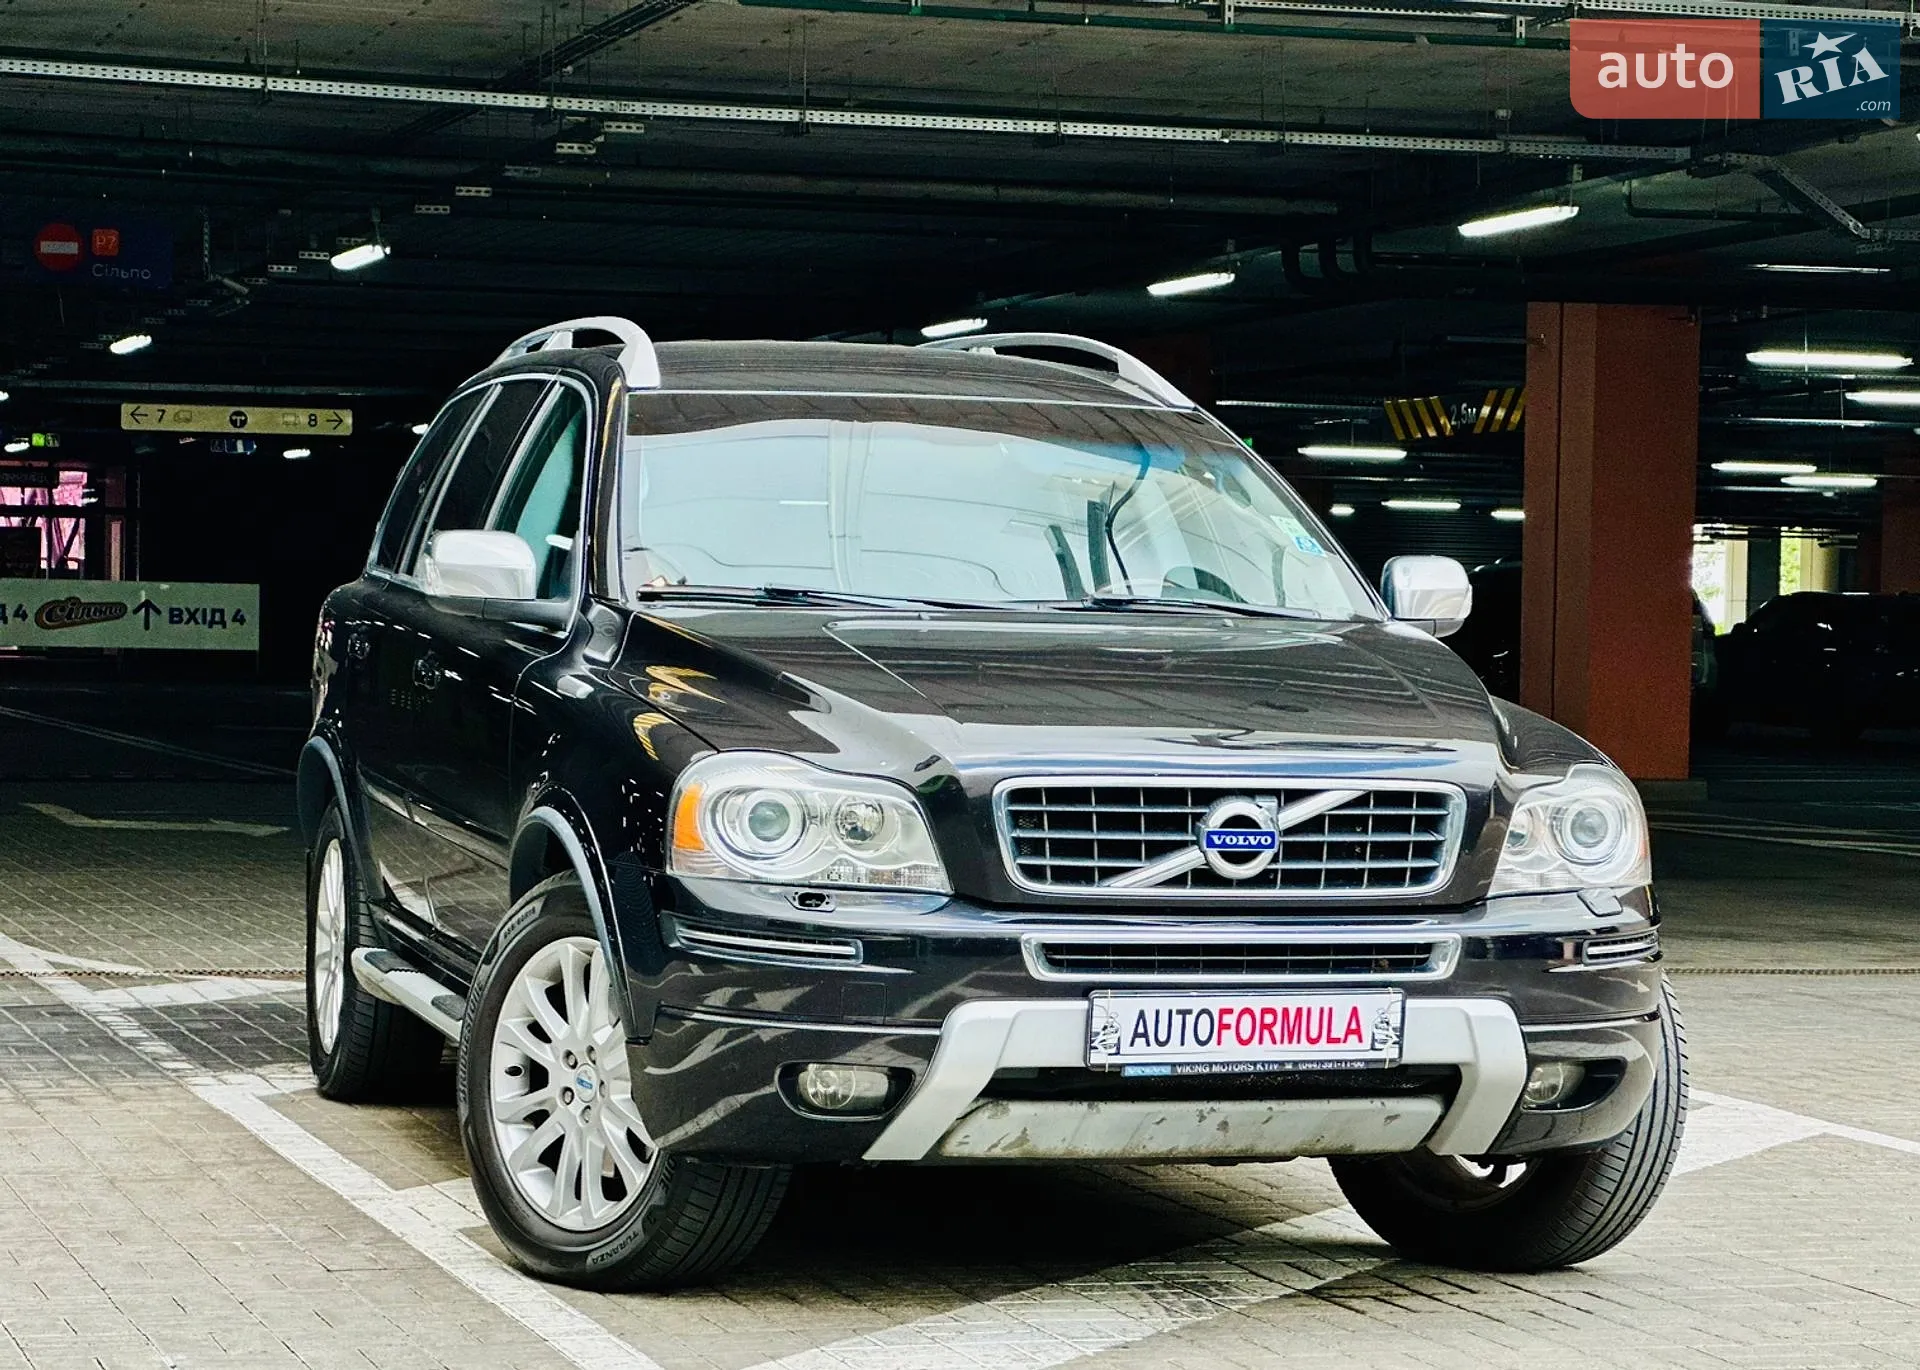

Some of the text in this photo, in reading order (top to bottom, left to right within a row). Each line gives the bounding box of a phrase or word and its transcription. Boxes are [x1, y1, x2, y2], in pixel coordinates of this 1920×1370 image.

[92, 263, 152, 280] Сільпо
[157, 409, 165, 423] 7
[308, 413, 317, 427] 8
[13, 604, 28, 622] 4
[168, 607, 246, 628] ВХІД 4
[1210, 834, 1272, 845] VOLVO
[1129, 1006, 1364, 1047] AUTOFORMULA
[592, 1230, 640, 1265] TURANZA
